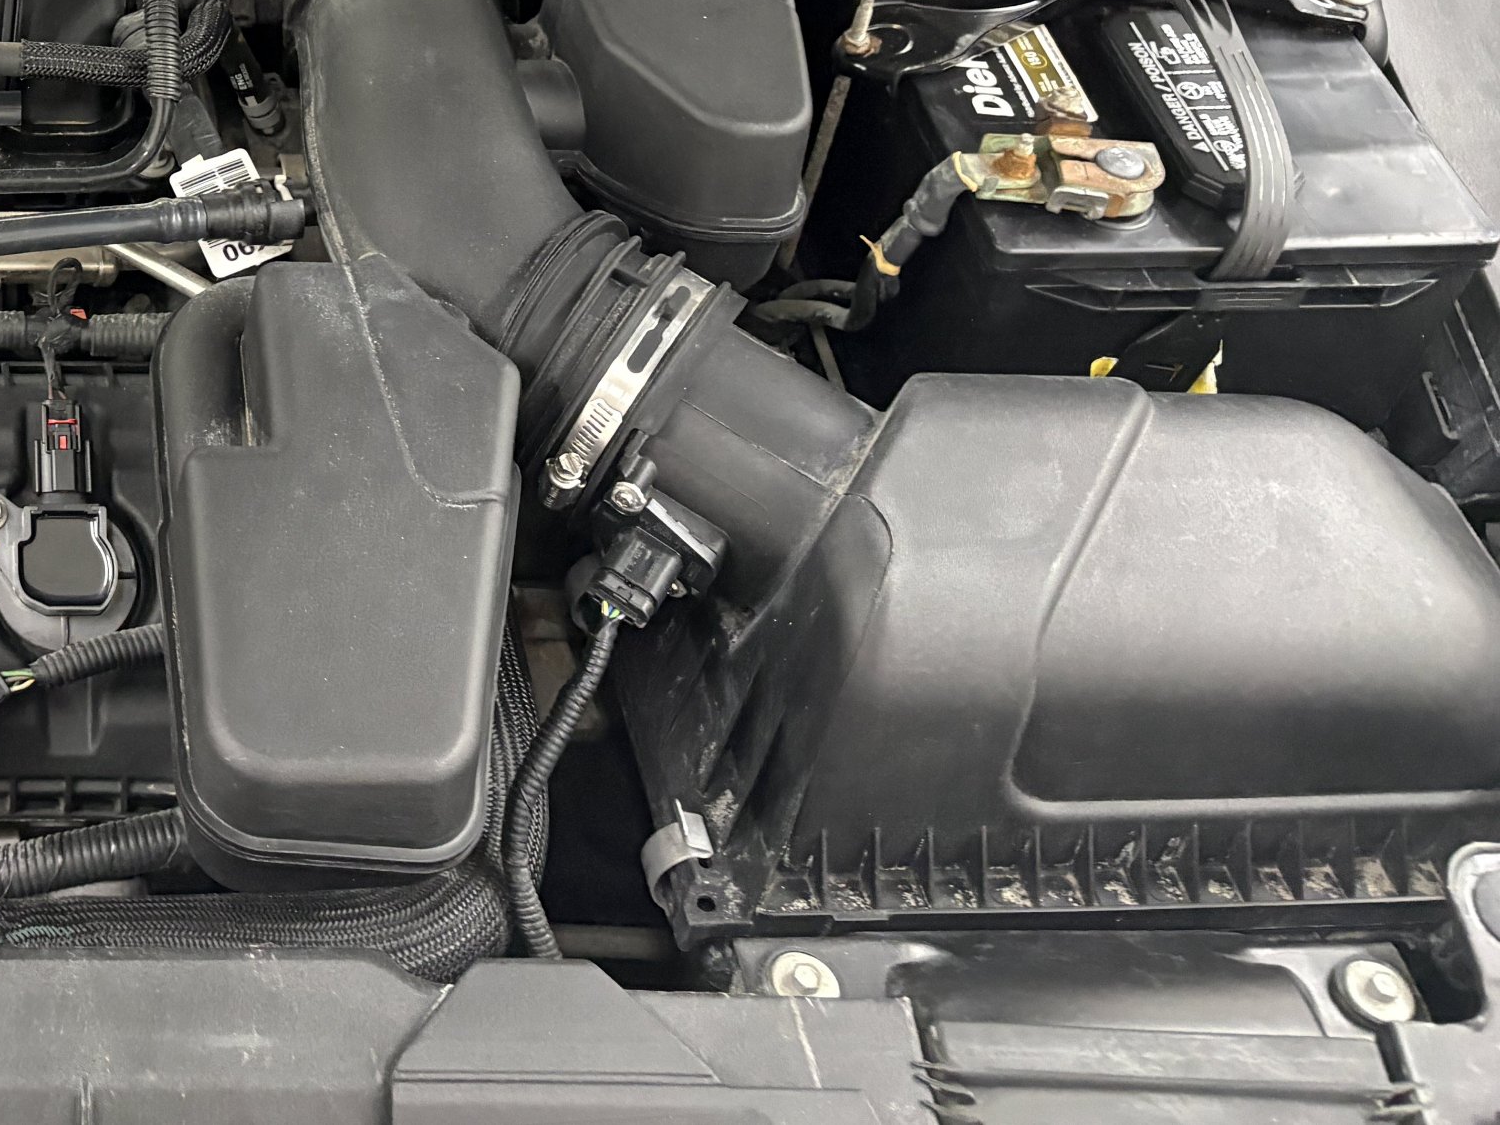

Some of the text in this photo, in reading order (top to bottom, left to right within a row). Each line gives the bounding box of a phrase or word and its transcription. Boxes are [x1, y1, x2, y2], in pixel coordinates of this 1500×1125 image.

[1128, 42, 1166, 83] POISON
[234, 73, 248, 90] ENG
[1161, 93, 1203, 140] DANGER
[223, 242, 265, 261] 06
